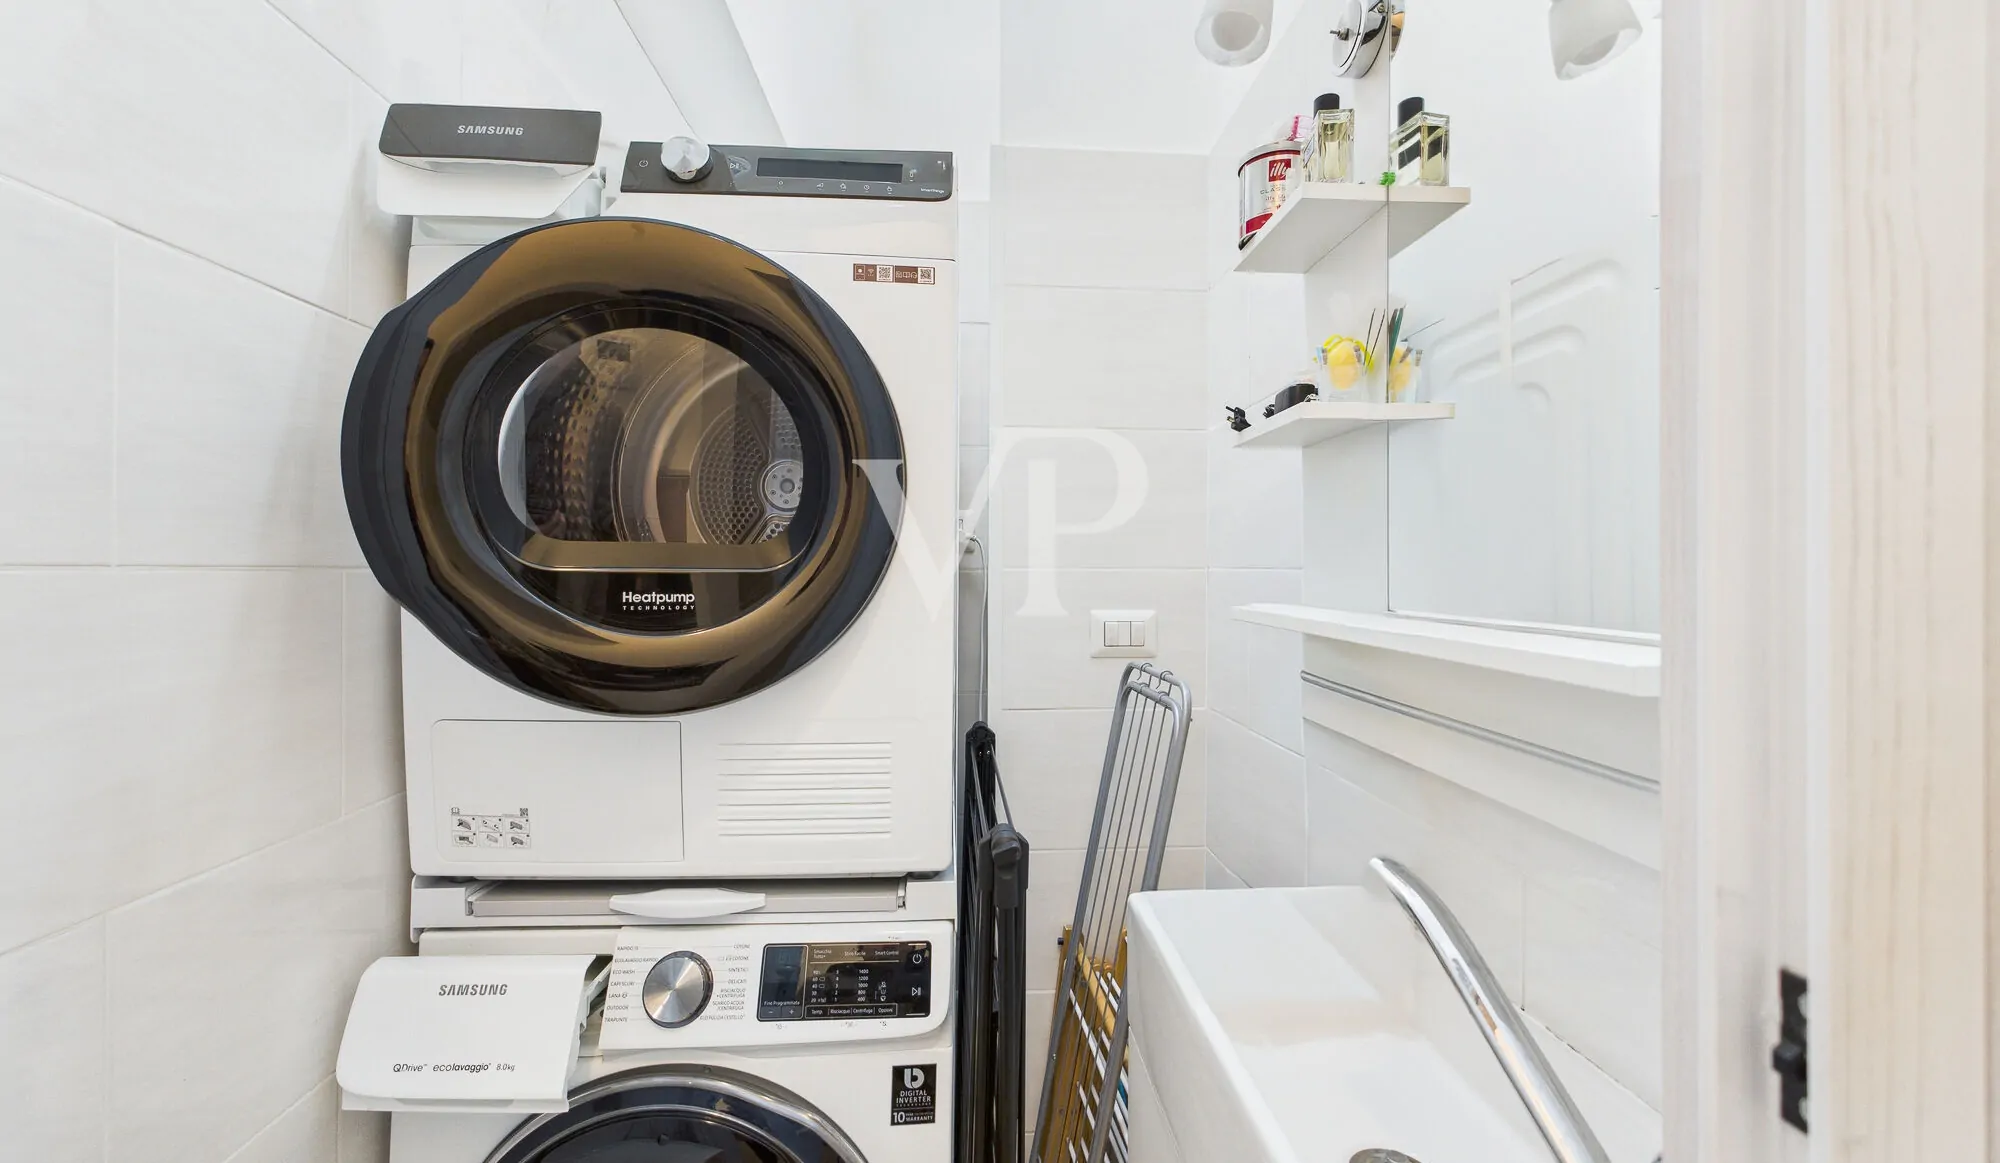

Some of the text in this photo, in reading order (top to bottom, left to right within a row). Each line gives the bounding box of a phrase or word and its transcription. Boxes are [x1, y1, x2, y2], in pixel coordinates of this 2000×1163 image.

[457, 125, 524, 136] SAMSUNG
[622, 591, 696, 605] Heatpump
[438, 984, 508, 996] SAMSUNG
[900, 1089, 928, 1097] DIGITAL
[896, 1096, 932, 1104] INVERTER
[893, 1111, 906, 1124] 10
